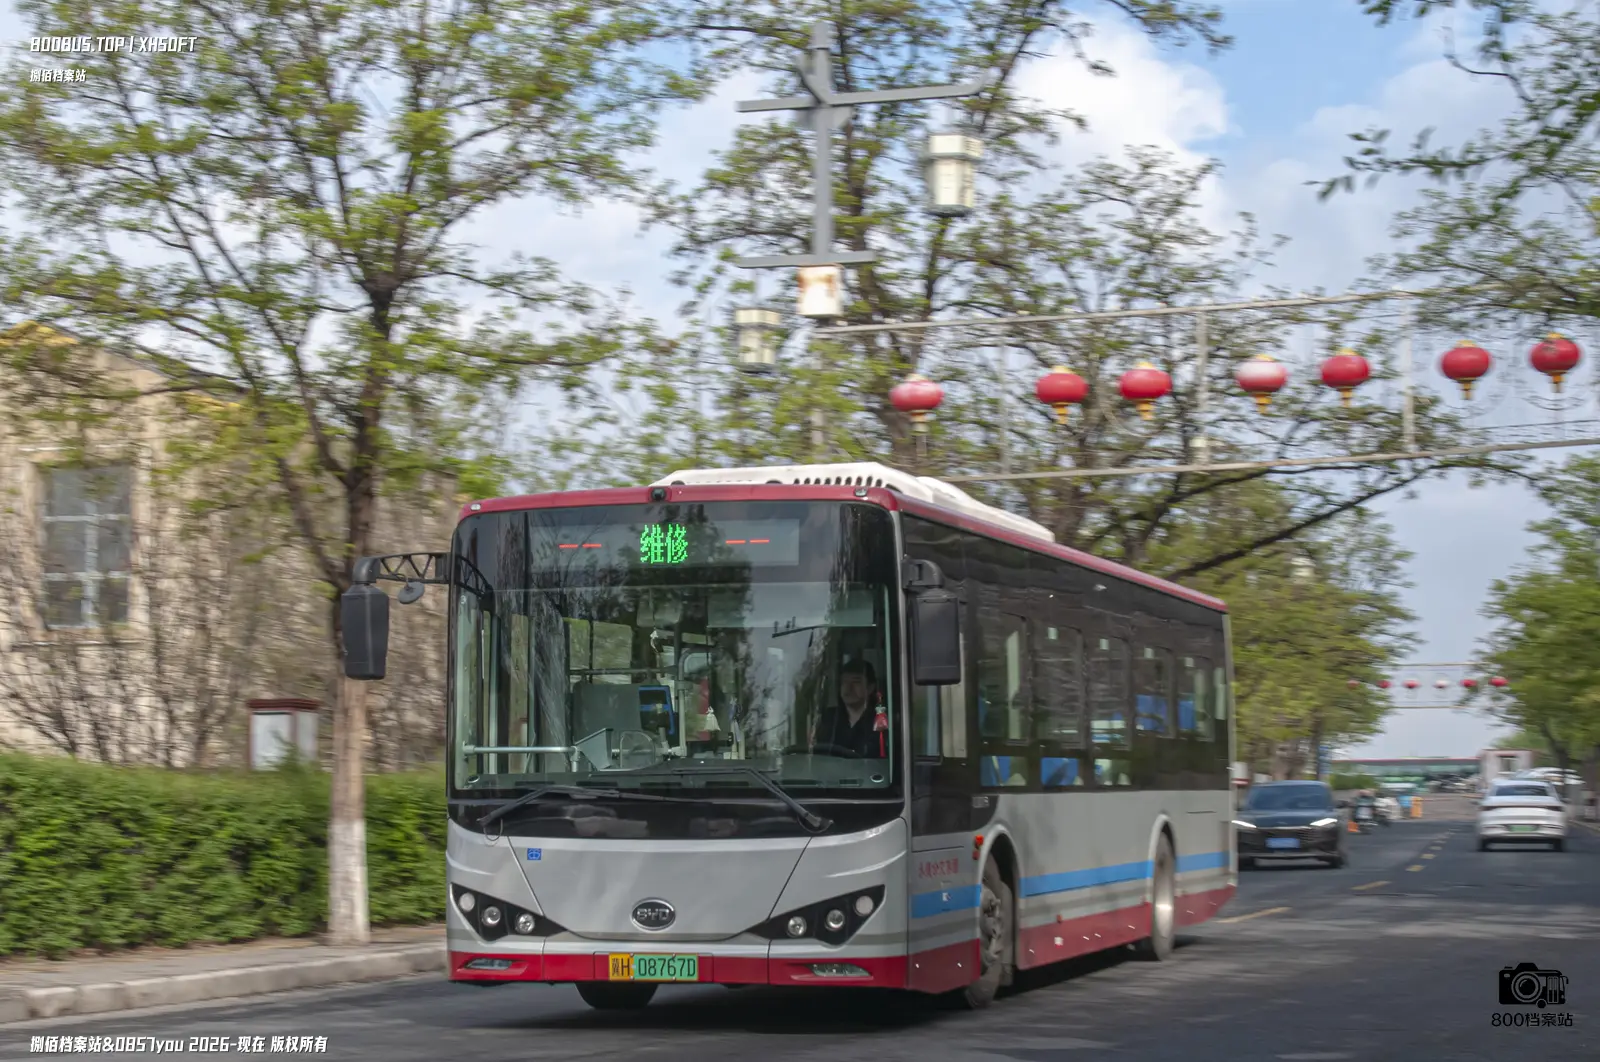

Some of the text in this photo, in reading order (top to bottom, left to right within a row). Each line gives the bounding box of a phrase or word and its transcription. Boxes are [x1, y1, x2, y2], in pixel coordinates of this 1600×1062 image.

[640, 524, 688, 564] 维修
[637, 908, 669, 921] BYD
[638, 957, 696, 977] 08767D
